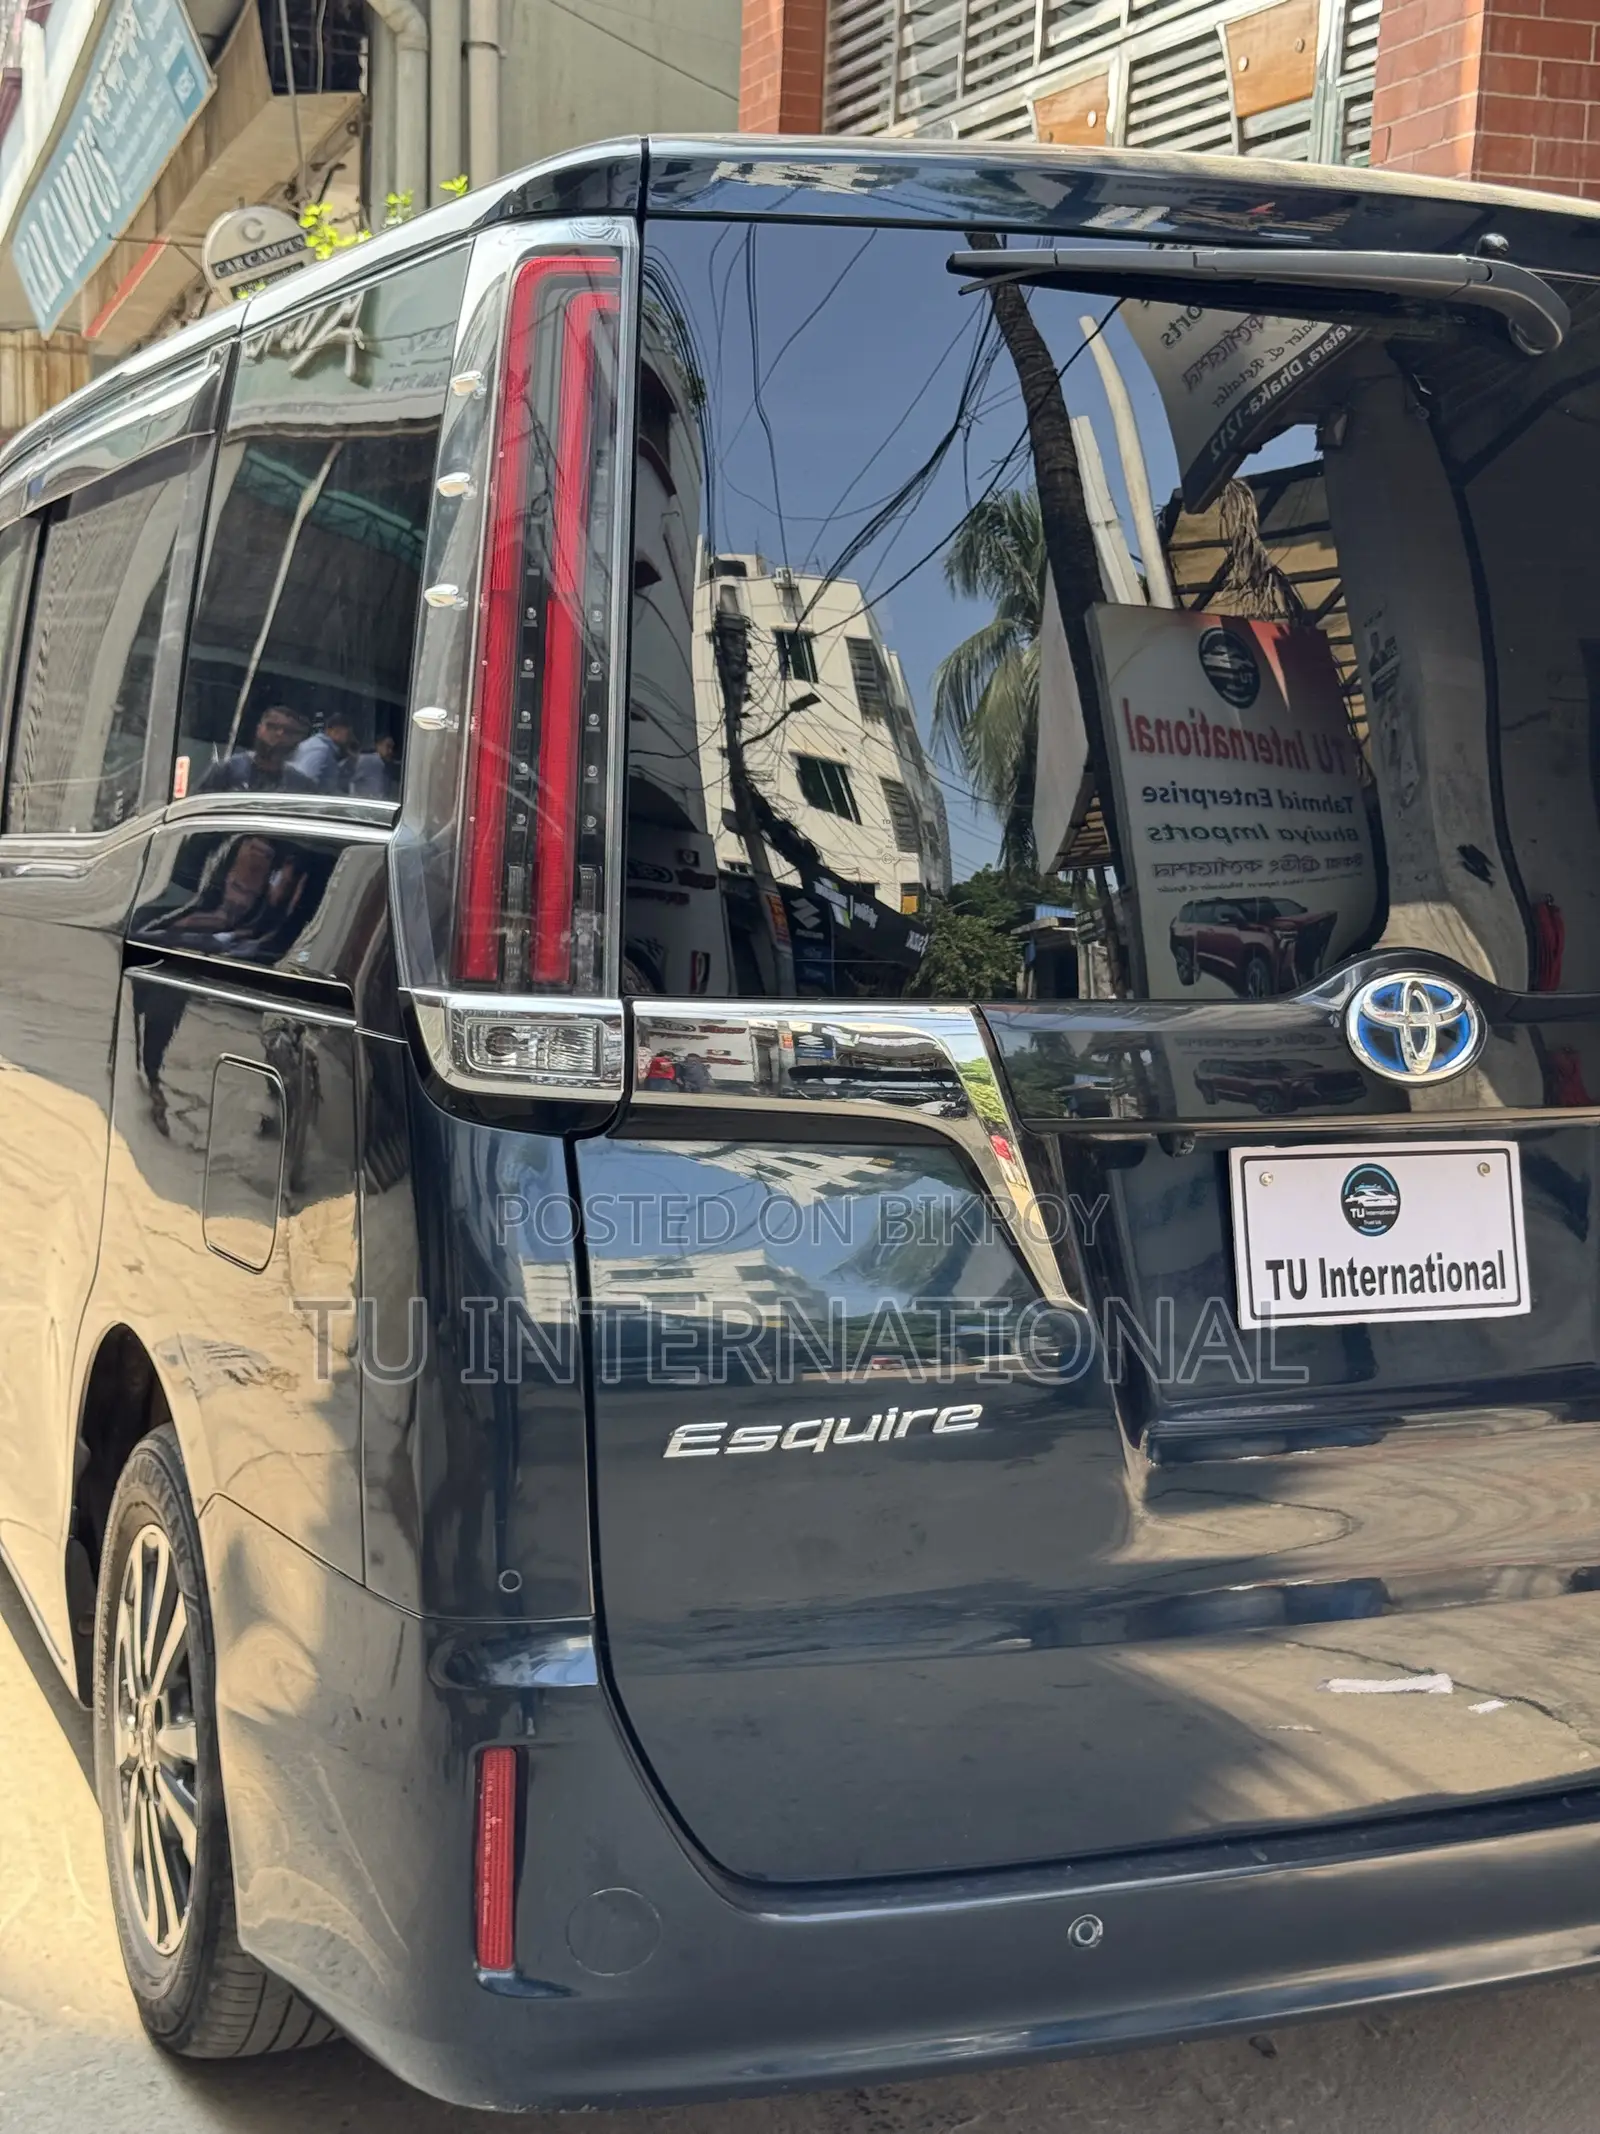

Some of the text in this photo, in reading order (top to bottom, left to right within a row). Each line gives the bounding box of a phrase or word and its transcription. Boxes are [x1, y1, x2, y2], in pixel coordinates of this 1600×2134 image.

[1350, 1207, 1365, 1219] TU
[1265, 1249, 1507, 1301] TU International
[662, 1403, 984, 1459] Esquire
